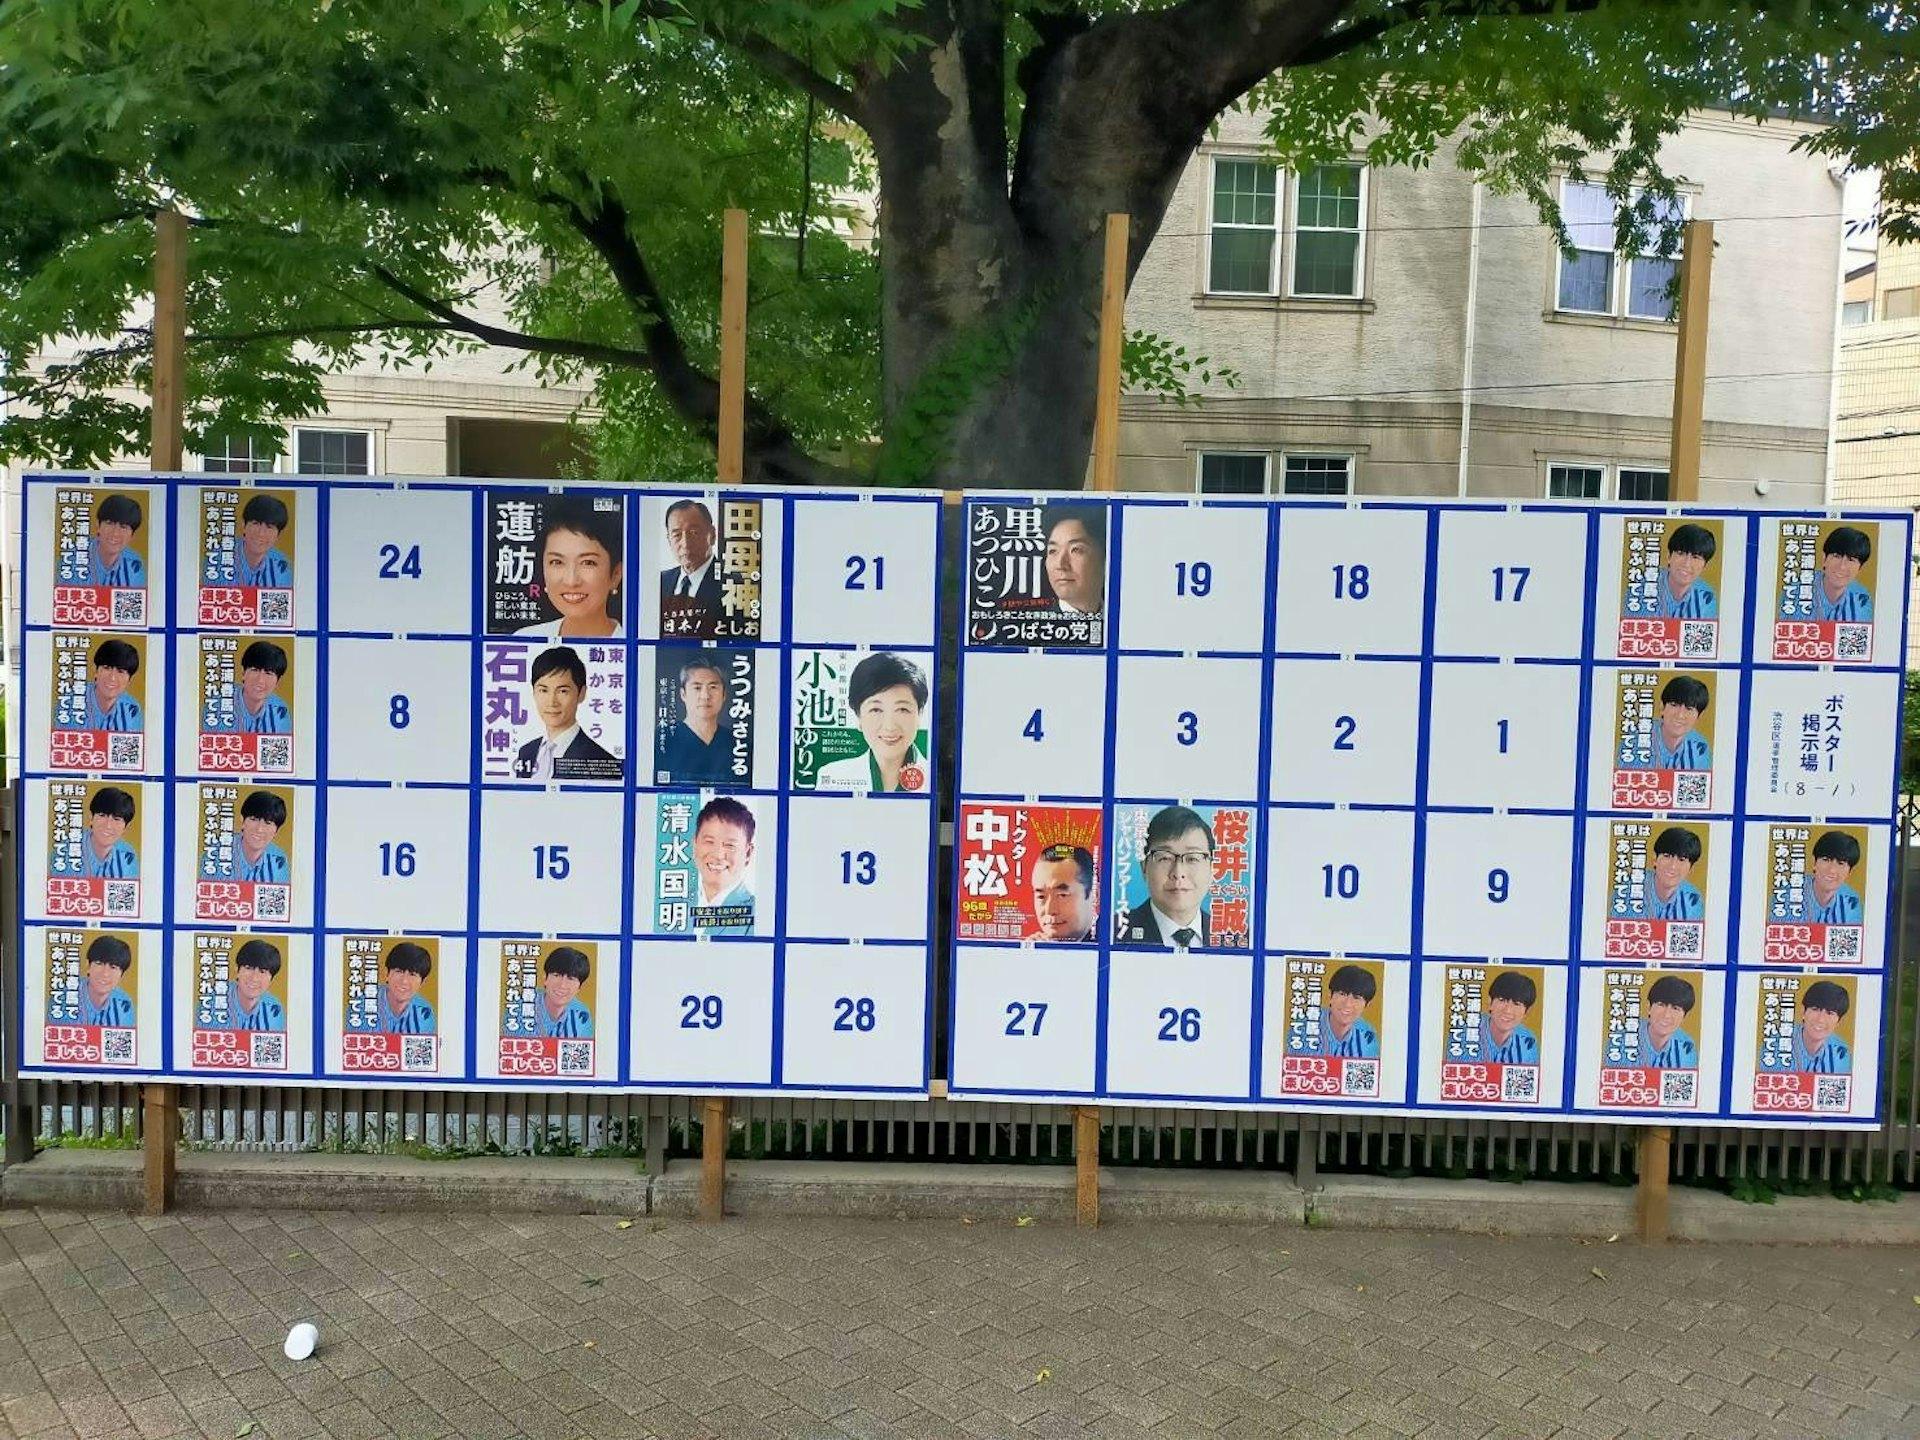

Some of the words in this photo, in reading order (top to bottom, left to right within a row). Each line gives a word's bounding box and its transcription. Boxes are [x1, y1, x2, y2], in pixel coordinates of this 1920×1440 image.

[58, 491, 94, 504] 世界は
[203, 492, 239, 504] 世界は
[1626, 522, 1665, 534] 世界は
[1782, 524, 1821, 537] 世界は
[60, 506, 75, 579] あふれてる
[206, 507, 220, 580] あふれてる
[495, 500, 536, 585] 蓮舫
[378, 542, 423, 581] 24
[722, 502, 760, 618] 田母神
[972, 507, 1000, 608] あつひこ
[999, 507, 1046, 598] 黒川
[844, 555, 885, 592] 21
[1176, 561, 1213, 597] 19
[1333, 564, 1370, 601] 18
[1628, 537, 1644, 611] あふれてる
[1783, 539, 1799, 614] あふれてる
[530, 584, 540, 598] R
[1493, 566, 1531, 602] 17
[54, 587, 97, 604] 選挙を
[200, 587, 243, 604] 選挙を
[54, 604, 110, 622] 楽しもう
[200, 605, 256, 622] 楽しもう
[714, 621, 759, 636] としお
[1002, 622, 1089, 640] つばさの党
[1620, 619, 1666, 636] 選挙を
[1775, 622, 1820, 639] 選挙を
[55, 636, 91, 648] 世界は
[201, 639, 238, 651] 世界は
[1619, 637, 1679, 655] 楽しもう
[1774, 639, 1834, 657] 楽しもう
[58, 651, 72, 724] あふれてる
[608, 648, 624, 714] 東京を
[1620, 674, 1658, 686] 世界は
[205, 654, 220, 726] あふれてる
[588, 648, 605, 738] 動かそう
[388, 693, 412, 731] 8
[485, 644, 528, 776] 石丸伸二
[729, 654, 752, 776] うつみさとる
[1022, 708, 1045, 742] 4
[1176, 711, 1198, 747] 3
[1333, 715, 1357, 751] 2
[1621, 689, 1638, 762] あふれてる
[1825, 694, 1844, 772] ポスター
[52, 731, 94, 748] 選挙を
[200, 734, 243, 751] 選挙を
[1497, 719, 1510, 754] 1
[1800, 714, 1820, 772] 掲示場
[51, 748, 107, 766] 楽しもう
[200, 751, 256, 768] 楽しもう
[1614, 770, 1659, 787] 選挙を
[51, 784, 87, 797] 世界は
[202, 788, 238, 800] 世界は
[1613, 788, 1672, 805] 楽しもう
[54, 799, 68, 871] あふれてる
[204, 802, 219, 874] あふれてる
[1613, 824, 1651, 837] 世界は
[1772, 829, 1810, 841] 世界は
[963, 808, 1009, 896] 中松
[1212, 808, 1249, 883] 桜井
[380, 841, 416, 879] 16
[534, 844, 571, 880] 15
[660, 803, 692, 932] 清水国明
[841, 851, 877, 886] 13
[1324, 863, 1360, 901] 10
[1614, 839, 1630, 913] あふれてる
[1773, 844, 1789, 917] あふれてる
[48, 878, 90, 895] 選挙を
[198, 882, 240, 899] 選挙を
[1209, 885, 1248, 896] さくらい
[1487, 867, 1511, 904] 9
[48, 895, 103, 913] 楽しもう
[197, 899, 253, 917] 楽しもう
[1210, 899, 1248, 935] 誠
[1607, 920, 1652, 937] 選挙を
[1766, 924, 1811, 941] 選挙を
[48, 932, 84, 945] 世界は
[196, 937, 232, 950] 世界は
[345, 940, 382, 953] 世界は
[1210, 935, 1248, 947] まこと
[1606, 938, 1665, 955] 楽しもう
[503, 945, 541, 957] 世界は
[1765, 942, 1824, 959] 楽しもう
[1288, 962, 1326, 975] 世界は
[1448, 969, 1486, 981] 世界は
[51, 947, 65, 1018] あふれてる
[199, 952, 214, 1023] あふれてる
[1607, 974, 1645, 986] 世界は
[1762, 978, 1800, 991] 世界は
[349, 955, 364, 1027] あふれてる
[506, 959, 521, 1031] あふれてる
[680, 993, 725, 1030] 29
[833, 996, 877, 1034] 28
[1004, 1001, 1049, 1036] 27
[1290, 977, 1306, 1049] あふれてる
[1450, 984, 1466, 1056] あふれてる
[1158, 1006, 1202, 1043] 26
[1609, 988, 1625, 1061] あふれてる
[1763, 993, 1779, 1066] あふれてる
[45, 1026, 87, 1042] 選挙を
[194, 1030, 236, 1047] 選挙を
[344, 1034, 387, 1050] 選挙を
[45, 1042, 100, 1060] 楽しもう
[500, 1038, 544, 1055] 選挙を
[193, 1047, 250, 1065] 楽しもう
[344, 1051, 400, 1068] 楽しもう
[500, 1055, 557, 1072] 楽しもう
[1283, 1056, 1328, 1074] 選挙を
[1443, 1063, 1487, 1080] 選挙を
[1601, 1068, 1646, 1085] 選挙を
[1282, 1074, 1341, 1092] 楽しもう
[1442, 1081, 1501, 1098] 楽しもう
[1755, 1073, 1800, 1090] 選挙を
[1600, 1086, 1659, 1103] 楽しもう
[1754, 1090, 1813, 1108] 楽しもう
